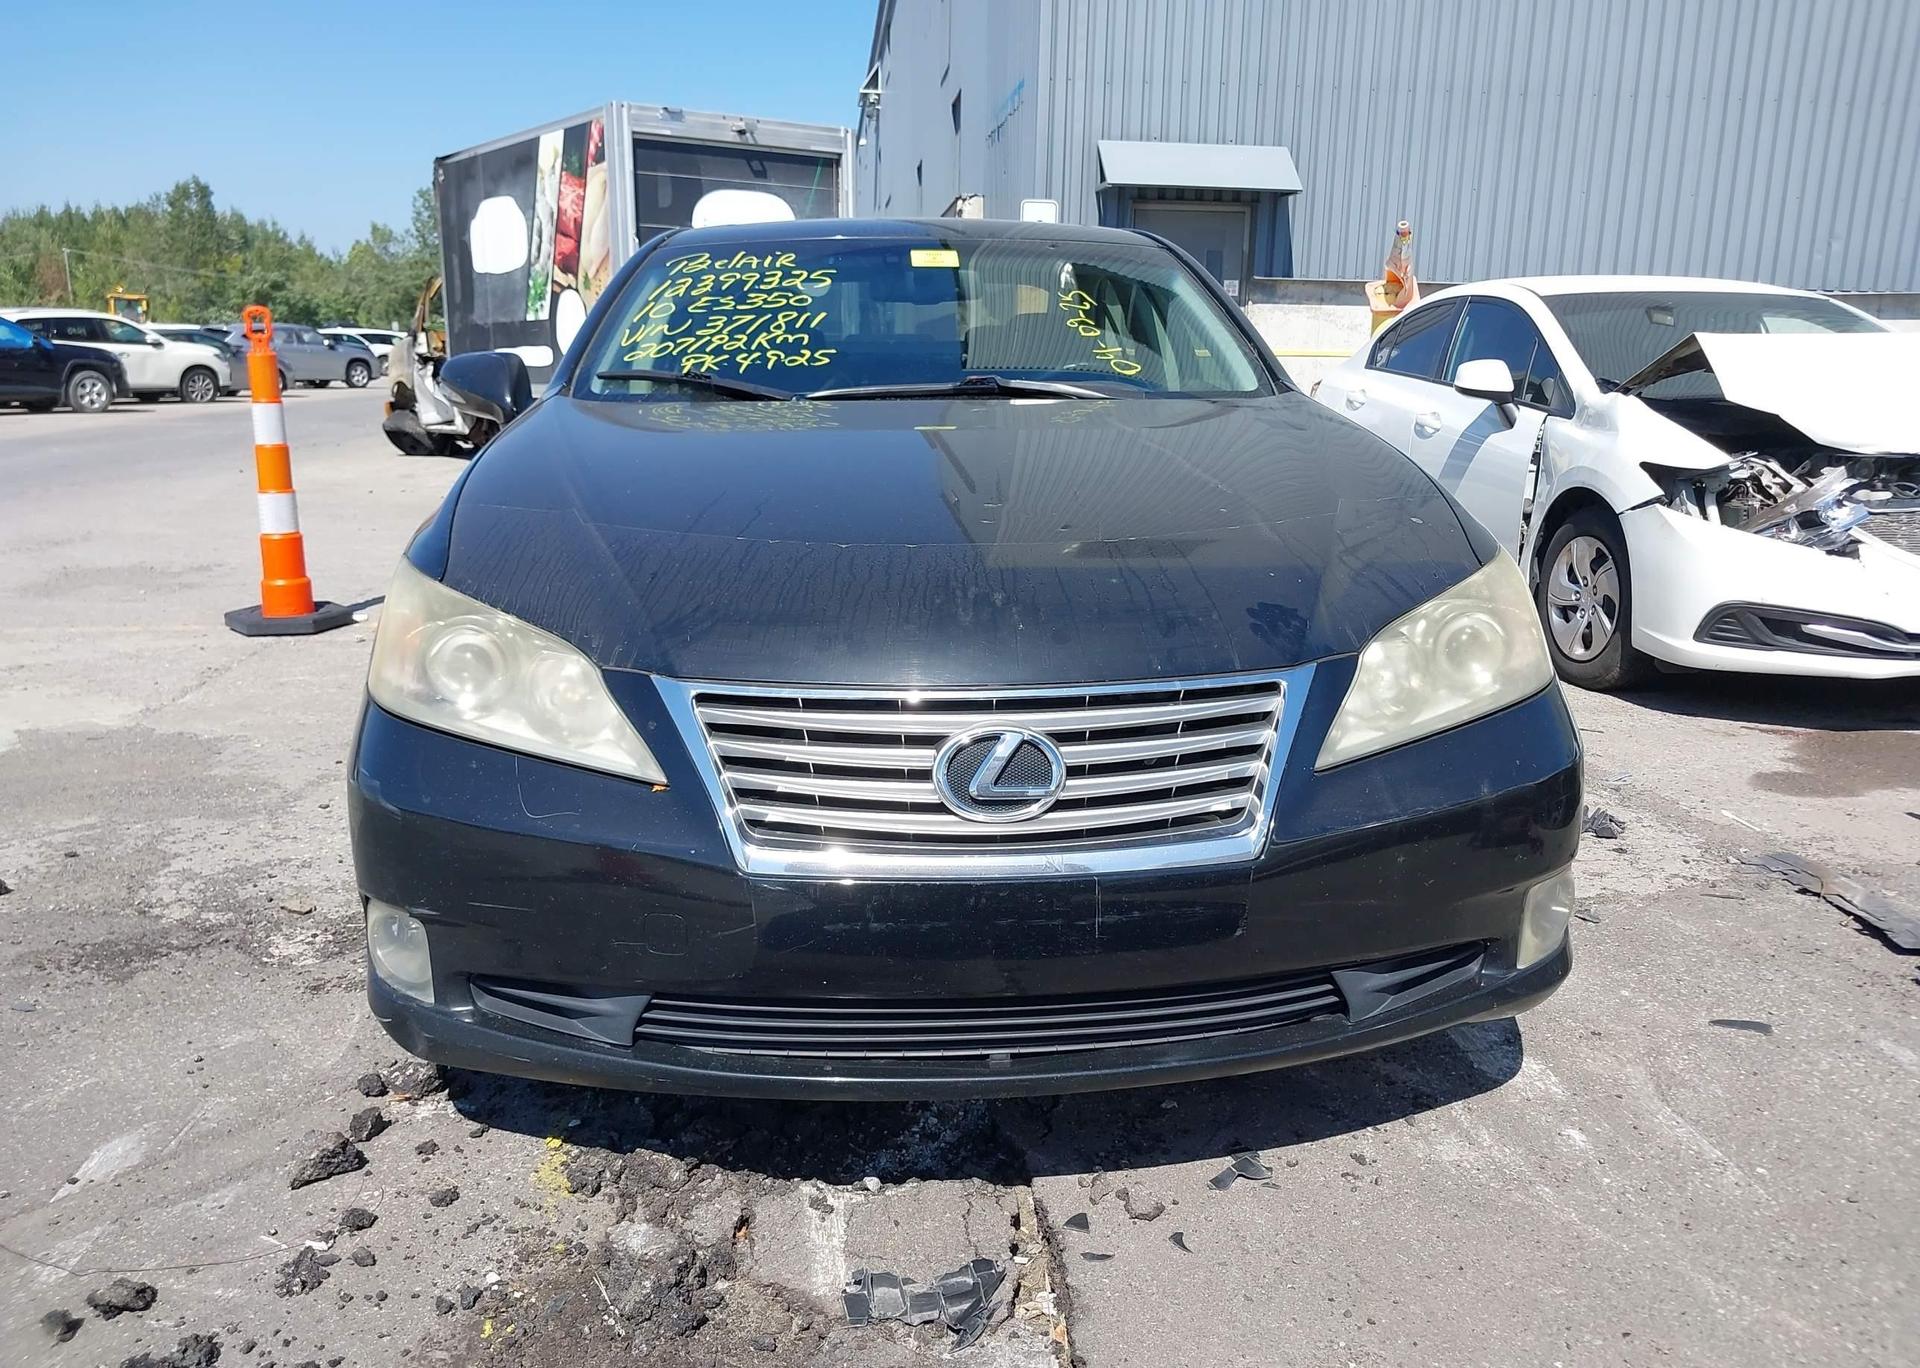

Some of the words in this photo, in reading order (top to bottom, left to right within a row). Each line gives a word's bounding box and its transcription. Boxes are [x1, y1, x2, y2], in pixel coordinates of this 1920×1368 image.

[649, 269, 838, 301] 12399325
[633, 300, 676, 323] 10
[696, 311, 827, 335] 371811
